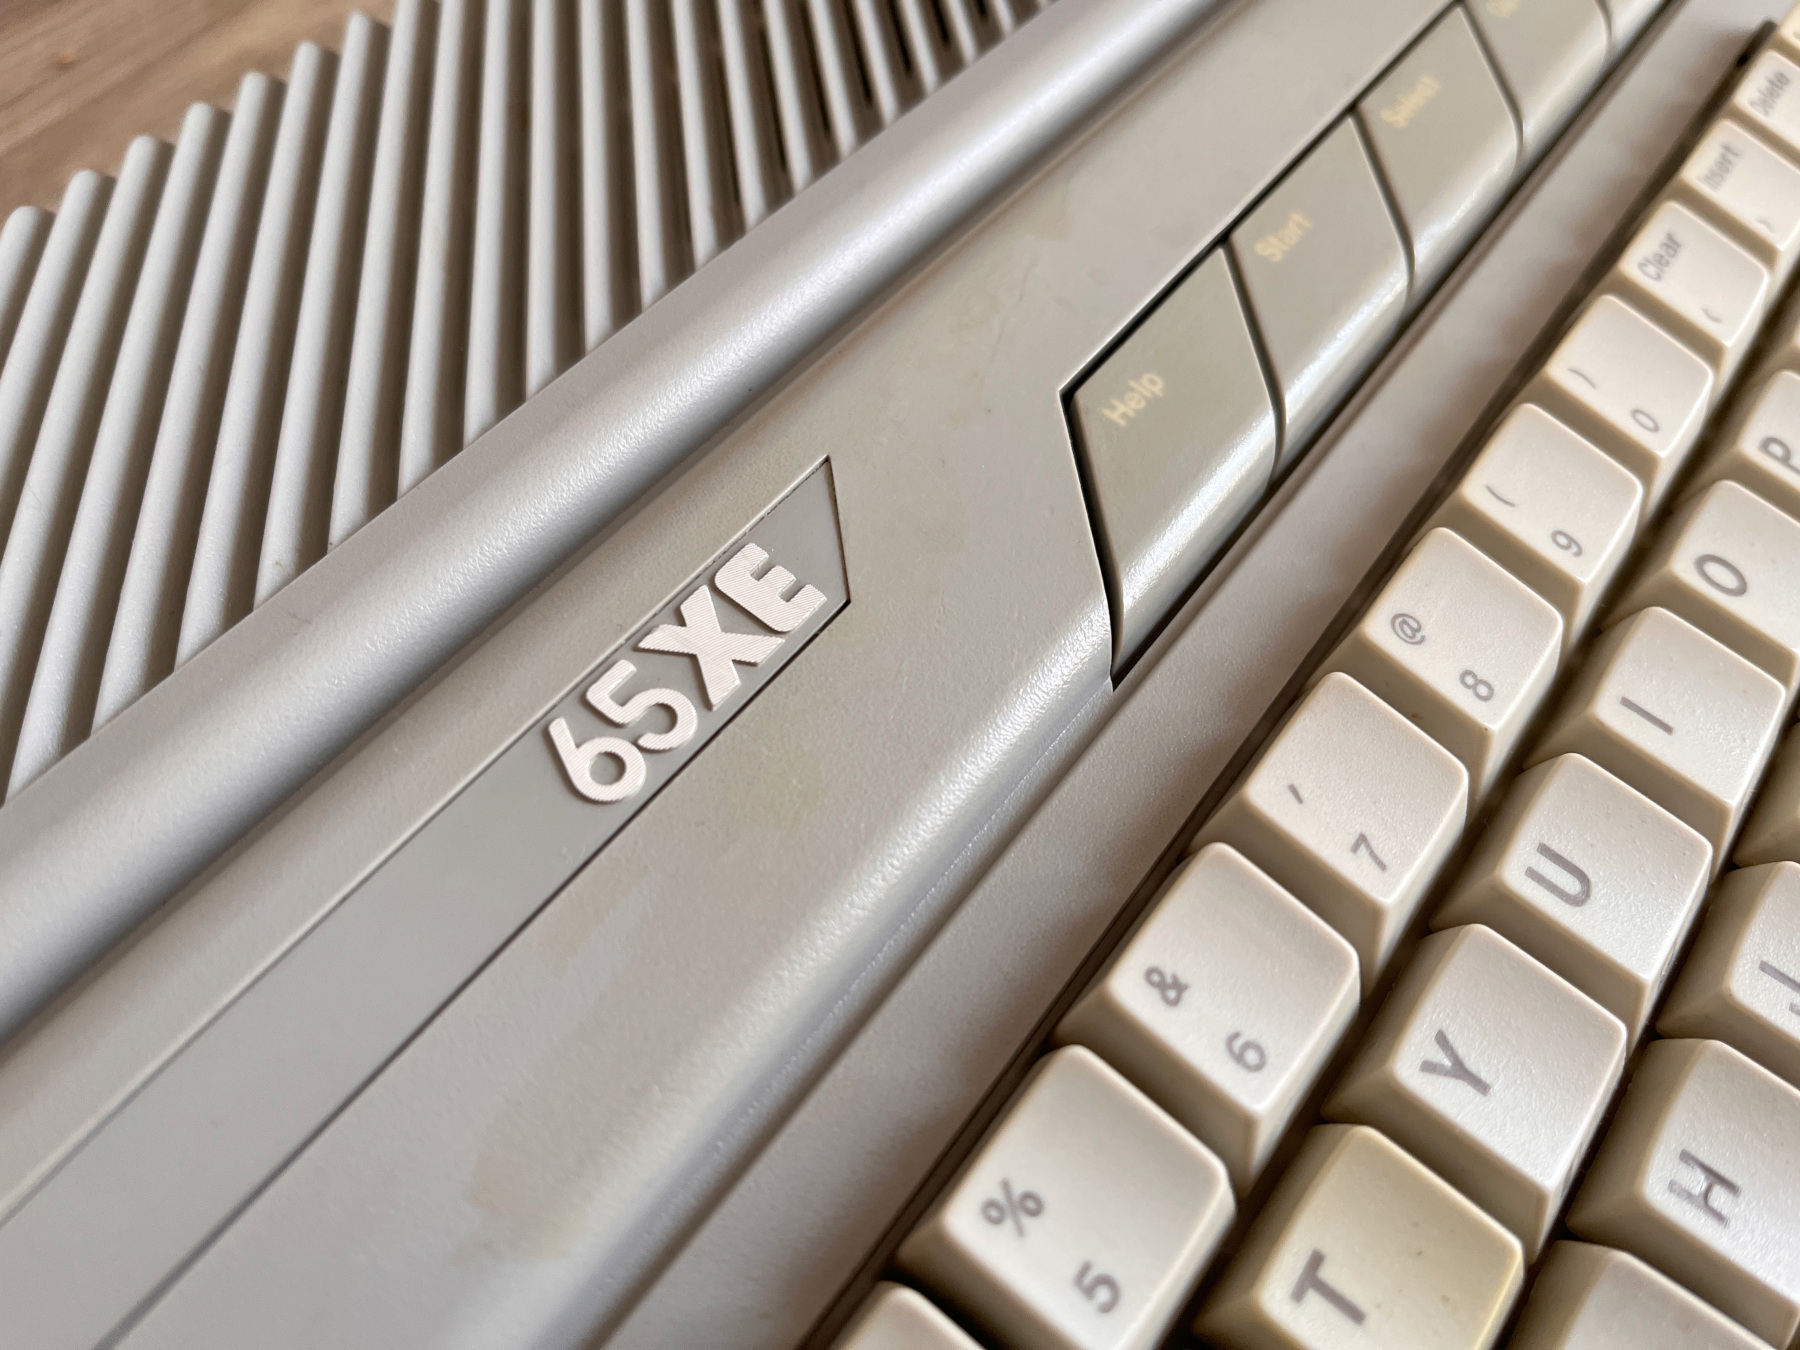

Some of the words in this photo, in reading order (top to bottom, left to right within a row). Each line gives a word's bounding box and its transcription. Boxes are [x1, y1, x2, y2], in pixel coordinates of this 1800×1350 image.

[1254, 211, 1313, 262] Start
[1637, 231, 1682, 282] Clear
[1568, 367, 1597, 389] )
[1102, 373, 1164, 427] Help
[1758, 437, 1800, 475] P
[1486, 485, 1515, 507] (
[1551, 530, 1583, 557] 9
[1694, 554, 1748, 597] O
[1390, 613, 1426, 645] @
[548, 542, 827, 802] 65XE
[1460, 670, 1494, 701] 8
[1620, 696, 1674, 735] I
[1351, 833, 1387, 871] 7
[1525, 842, 1591, 907] U
[1144, 967, 1190, 1007] &
[1225, 1032, 1266, 1072] 6
[1419, 1029, 1491, 1097] Y
[981, 1177, 1044, 1237] %
[1668, 1149, 1740, 1228] H
[1074, 1260, 1120, 1313] 5
[1289, 1248, 1366, 1326] T
